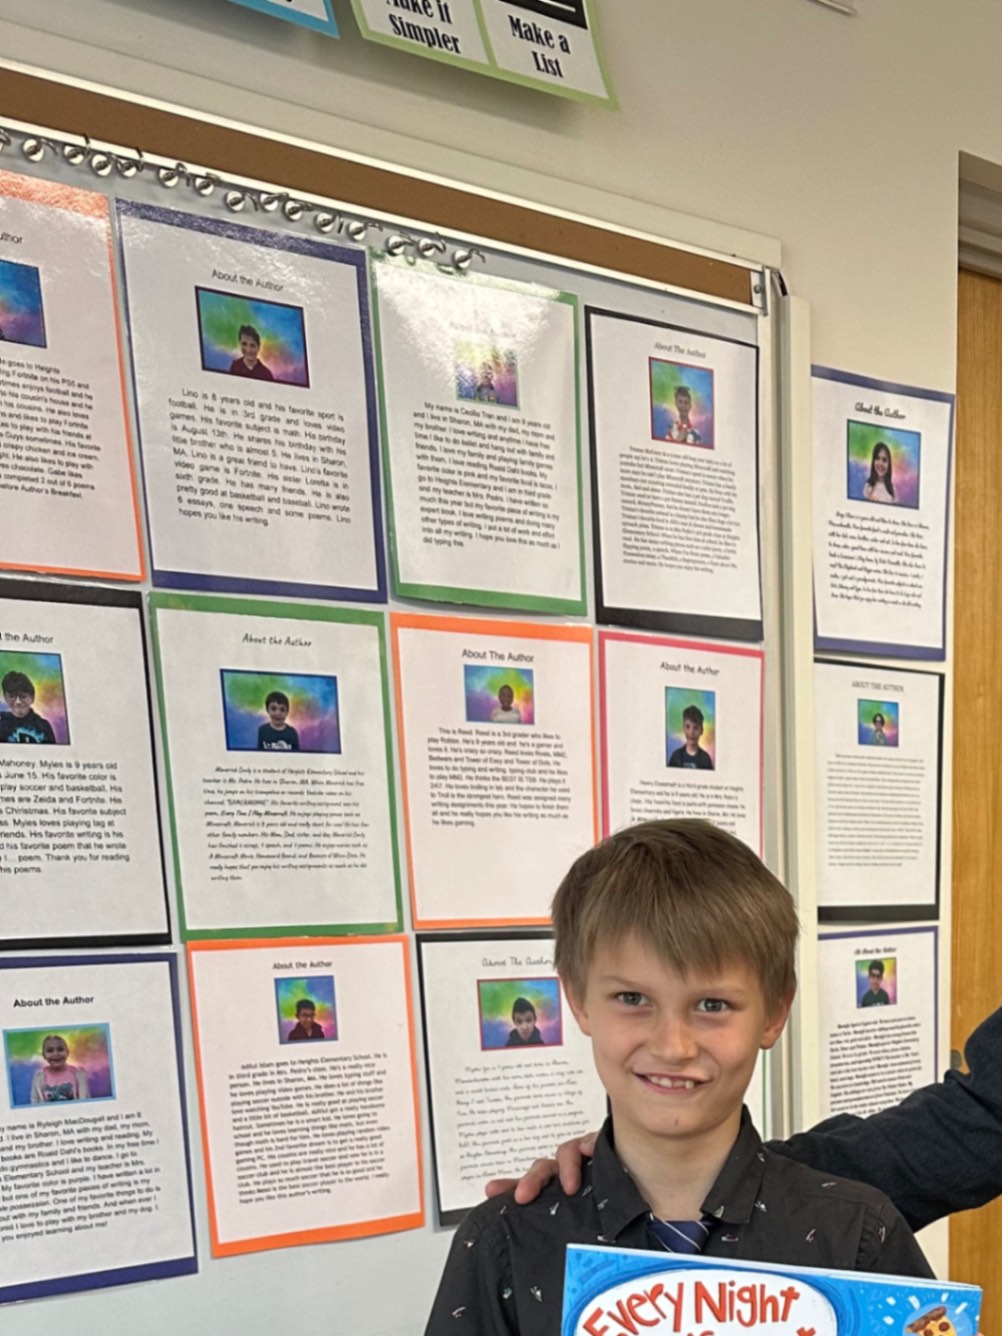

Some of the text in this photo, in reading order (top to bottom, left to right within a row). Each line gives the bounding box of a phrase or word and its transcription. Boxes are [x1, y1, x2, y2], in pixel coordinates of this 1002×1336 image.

[387, 0, 453, 24] ake it
[388, 14, 461, 54] Simpler
[508, 14, 571, 54] Make a
[531, 50, 564, 78] List
[212, 268, 283, 292] About the Author
[4, 632, 54, 644] the Author
[242, 633, 312, 648] About the Author
[462, 648, 534, 664] About The Author
[660, 661, 720, 676] About the Author
[272, 959, 333, 970] About the Author
[13, 994, 94, 1008] About the Author
